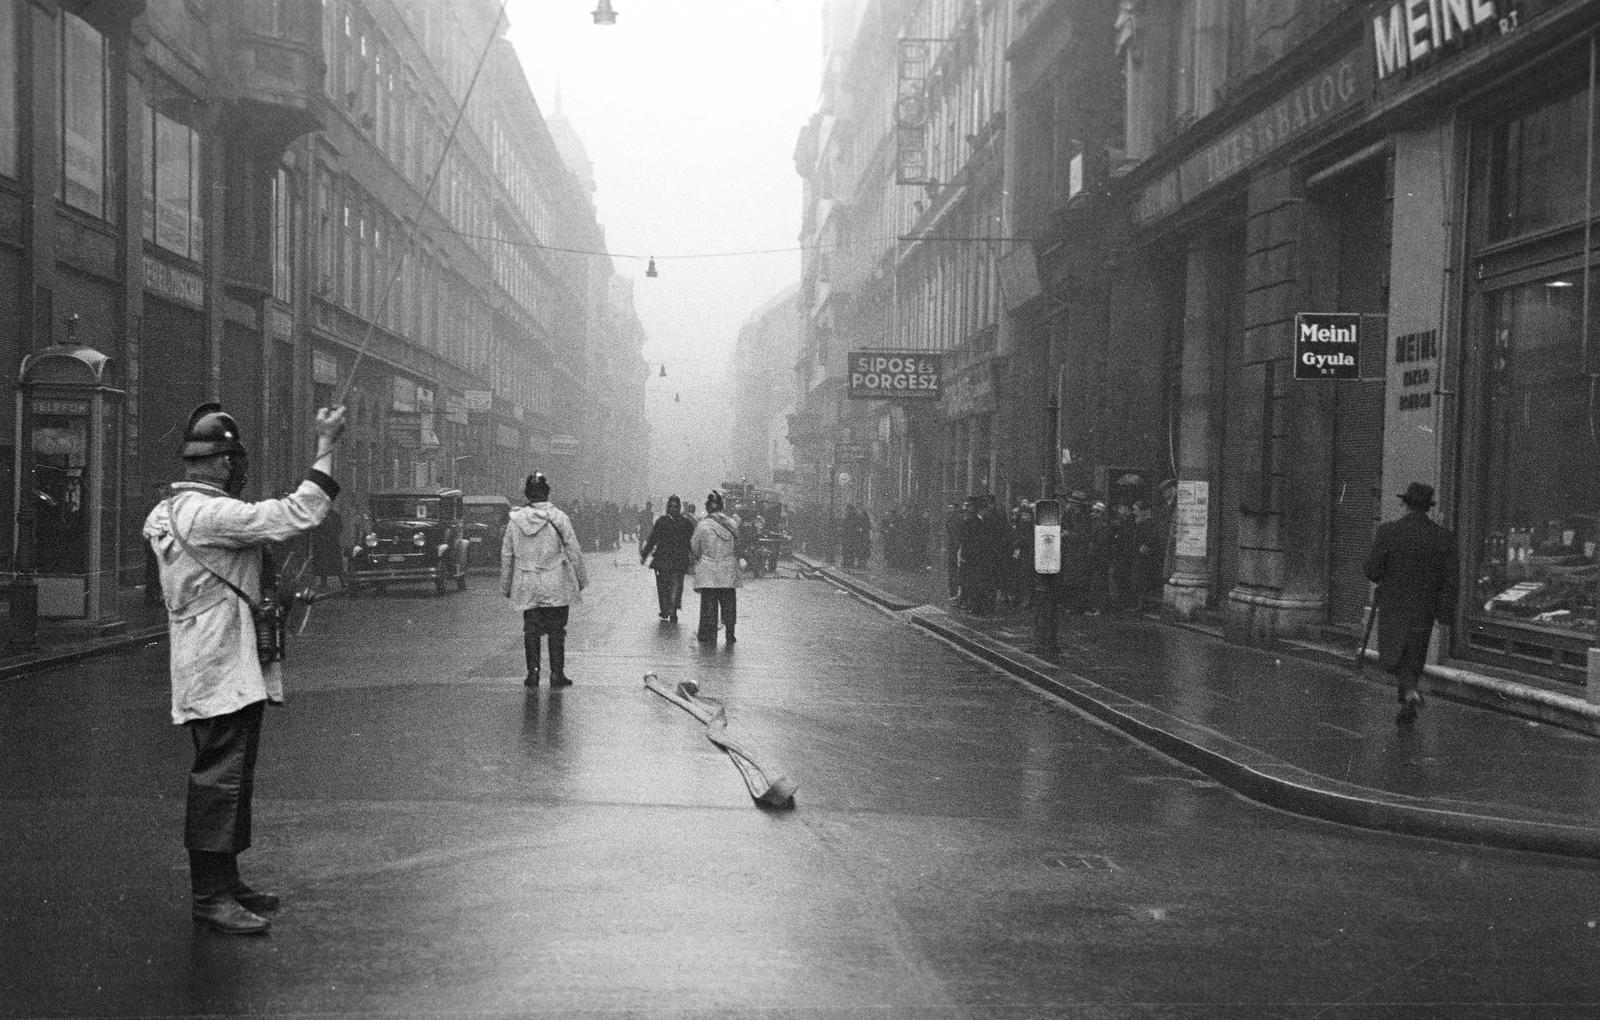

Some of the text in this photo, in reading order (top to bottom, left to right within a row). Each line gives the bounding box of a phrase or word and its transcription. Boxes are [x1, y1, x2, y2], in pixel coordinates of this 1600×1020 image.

[1300, 324, 1357, 342] Meinl
[858, 357, 915, 373] SIPOS
[1302, 352, 1355, 368] Gyula
[852, 374, 938, 389] PORGESZ
